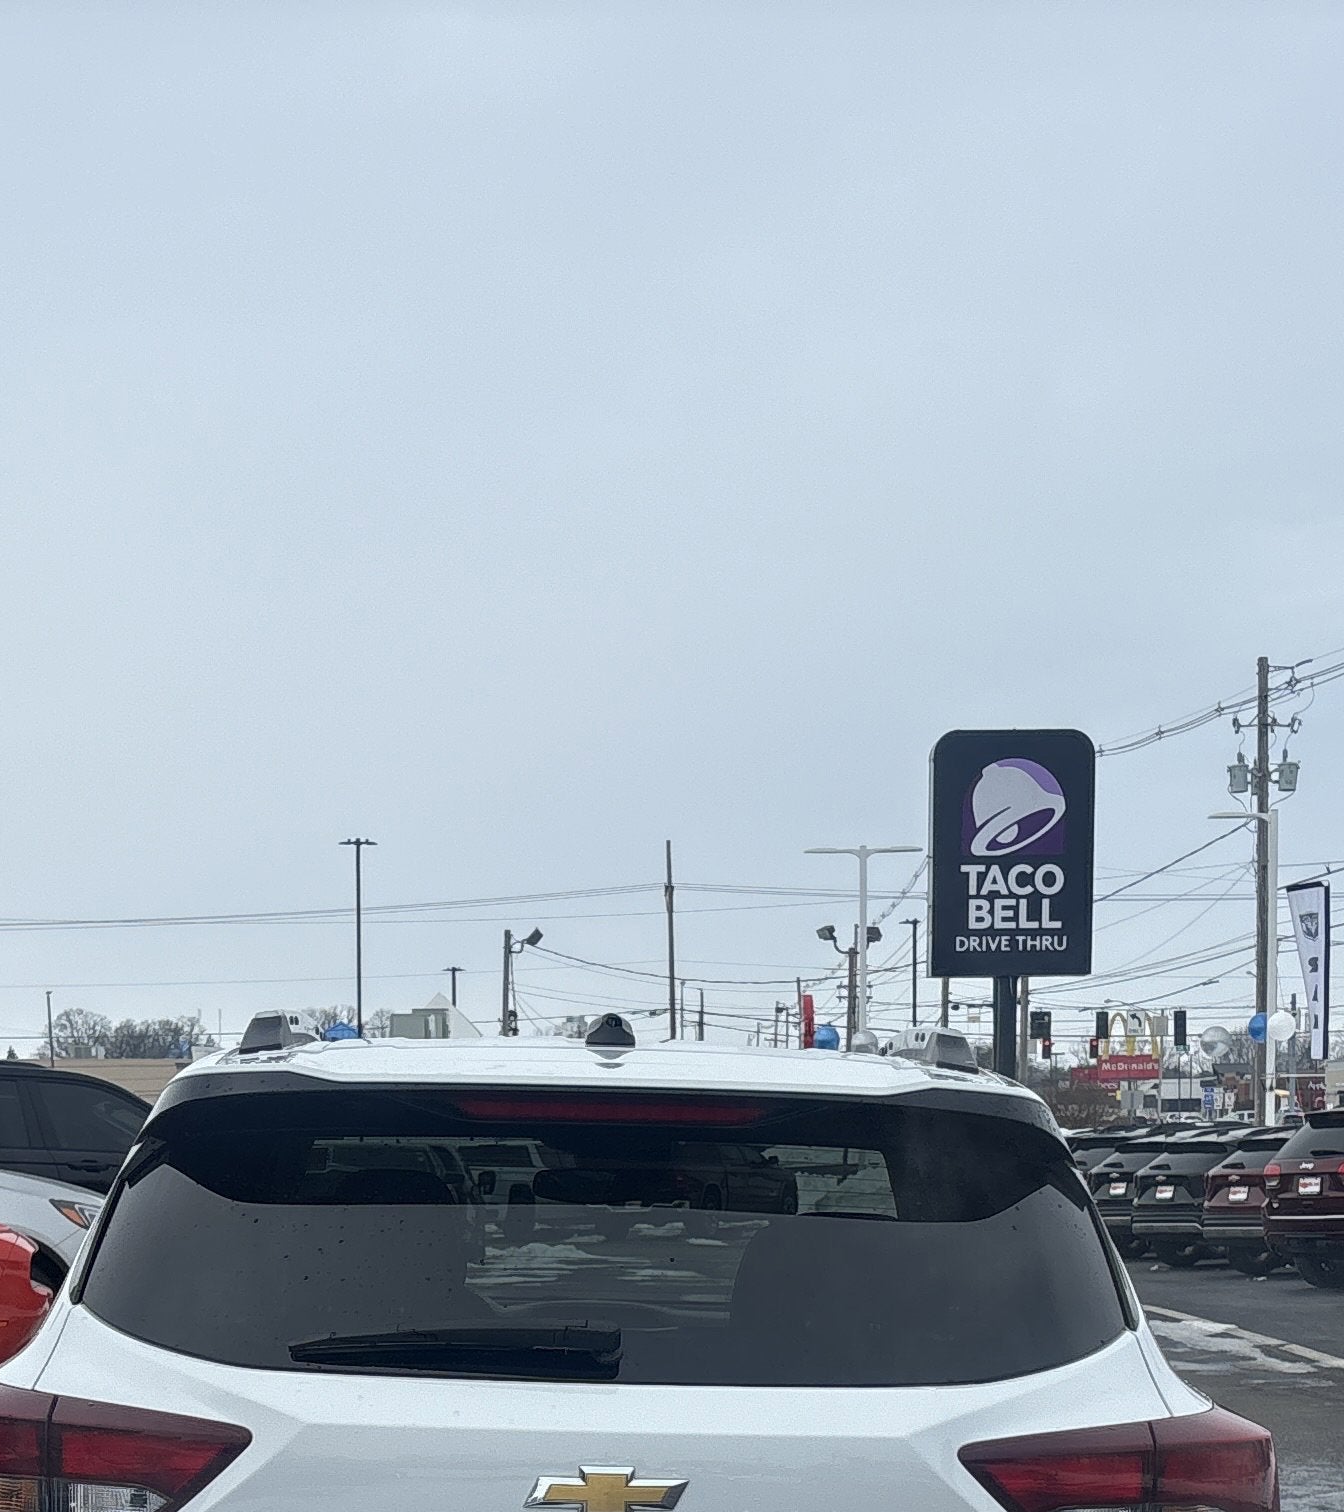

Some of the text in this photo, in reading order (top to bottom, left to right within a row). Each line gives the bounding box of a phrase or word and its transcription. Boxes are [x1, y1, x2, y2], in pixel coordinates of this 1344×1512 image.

[960, 863, 1065, 896] TACO
[967, 898, 1063, 930] BELL
[955, 934, 1068, 952] DRIVE THRU
